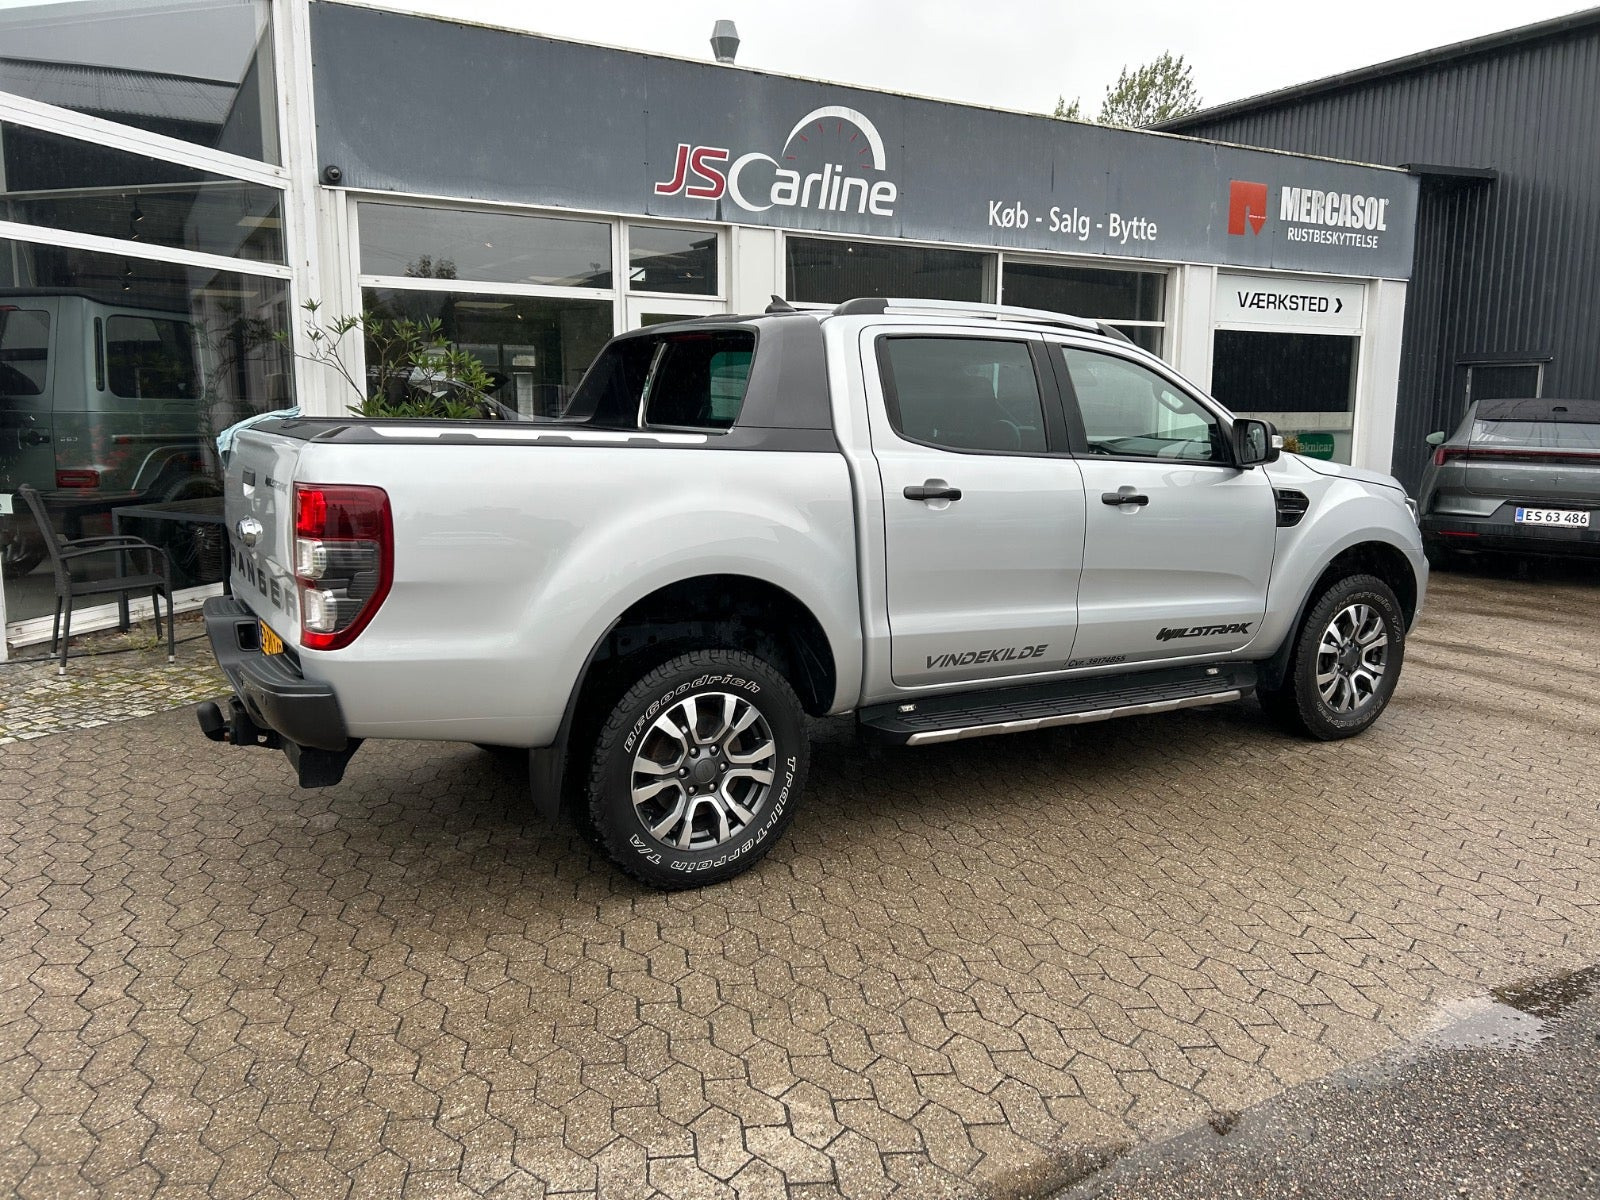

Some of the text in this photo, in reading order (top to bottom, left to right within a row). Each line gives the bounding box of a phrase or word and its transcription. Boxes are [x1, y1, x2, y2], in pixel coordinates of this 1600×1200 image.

[988, 200, 1029, 229] Køb
[1049, 206, 1091, 242] Salg
[1108, 213, 1158, 245] Bytte
[1287, 227, 1379, 249] RUSTBESKYTTELSE
[1237, 291, 1330, 313] VÆRKSTED
[1525, 510, 1588, 524] ES 63 486
[229, 542, 299, 623] RANGER
[1155, 622, 1254, 642] WILDTRAK
[926, 643, 1049, 669] VINDEKILDE
[623, 674, 761, 753] BFGoodrich
